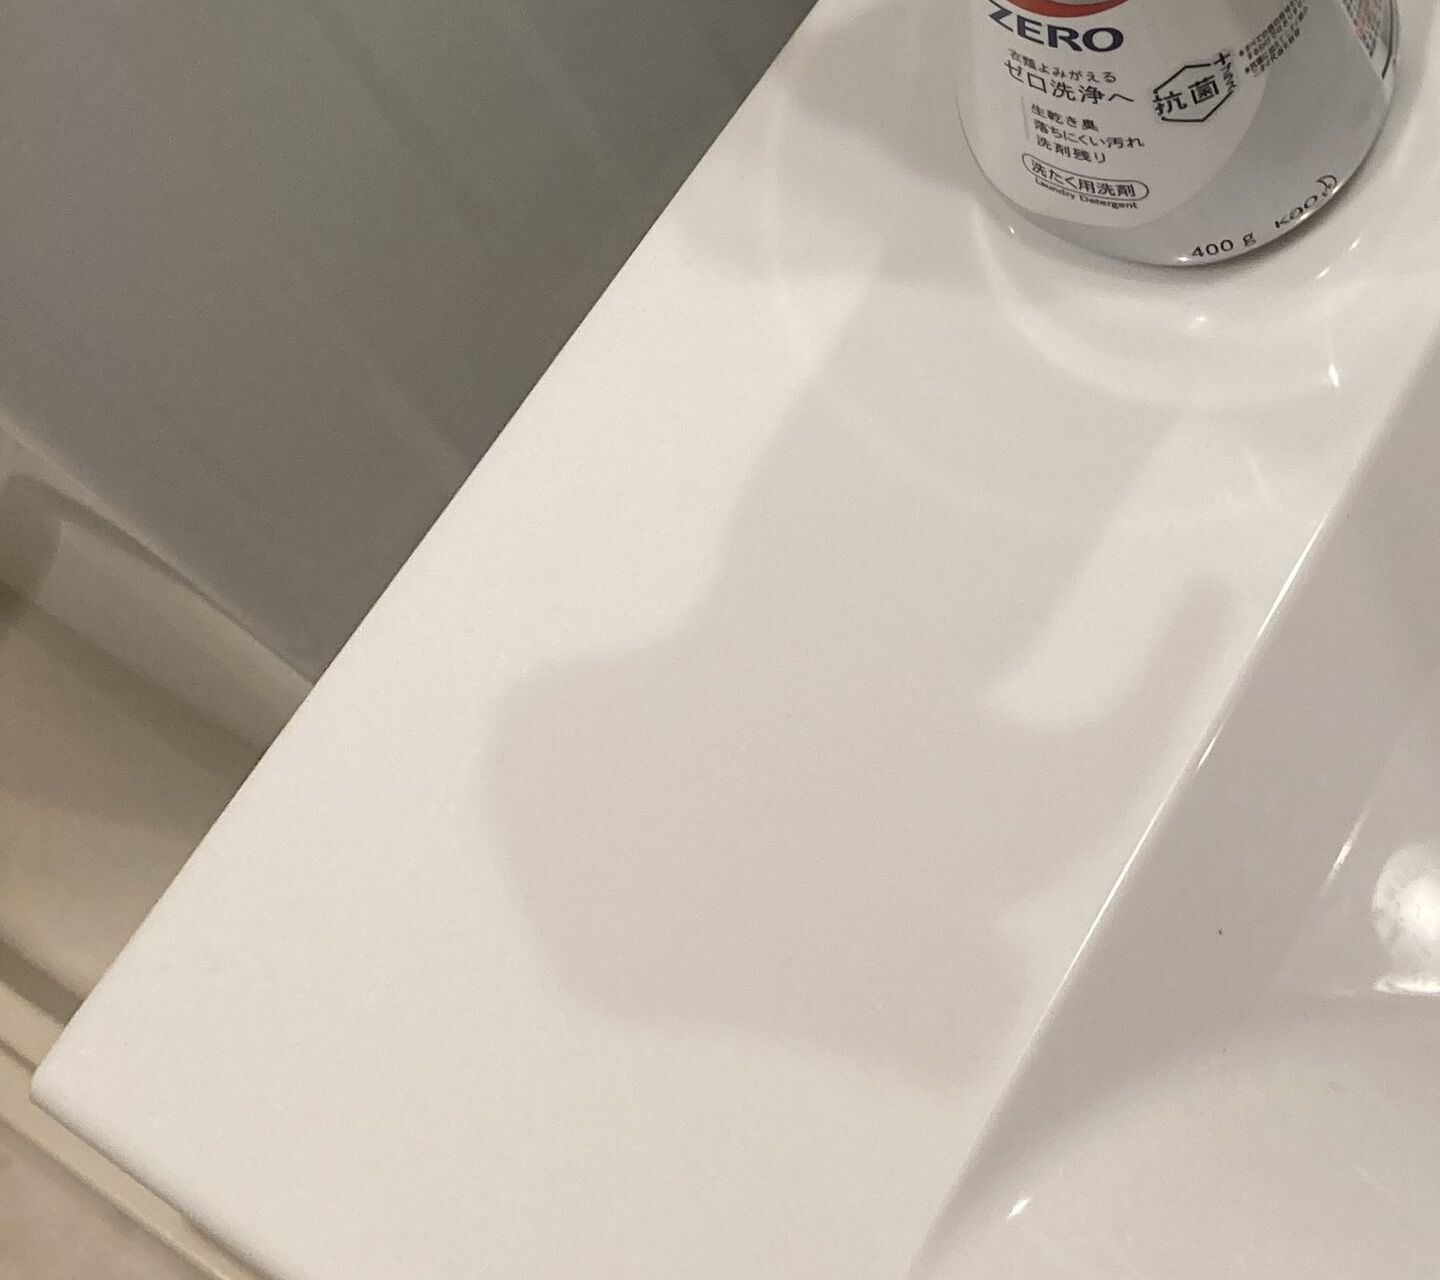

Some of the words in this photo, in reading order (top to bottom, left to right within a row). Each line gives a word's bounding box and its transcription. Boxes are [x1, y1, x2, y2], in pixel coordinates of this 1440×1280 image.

[1004, 60, 1134, 105] ゼロ洗浄へ
[1008, 48, 1117, 84] 衣類よみがえる
[1152, 75, 1220, 116] 抗菌
[1031, 103, 1099, 133] 生乾き臭
[1033, 118, 1145, 150] 落ちにくい汚れ
[1036, 134, 1106, 163] 洗剤残り
[1031, 159, 1136, 198] 洗たく用洗剤
[1034, 177, 1076, 200] Laundry
[1079, 194, 1138, 210] Detergent
[1192, 239, 1234, 258] 400
[1241, 232, 1257, 247] g
